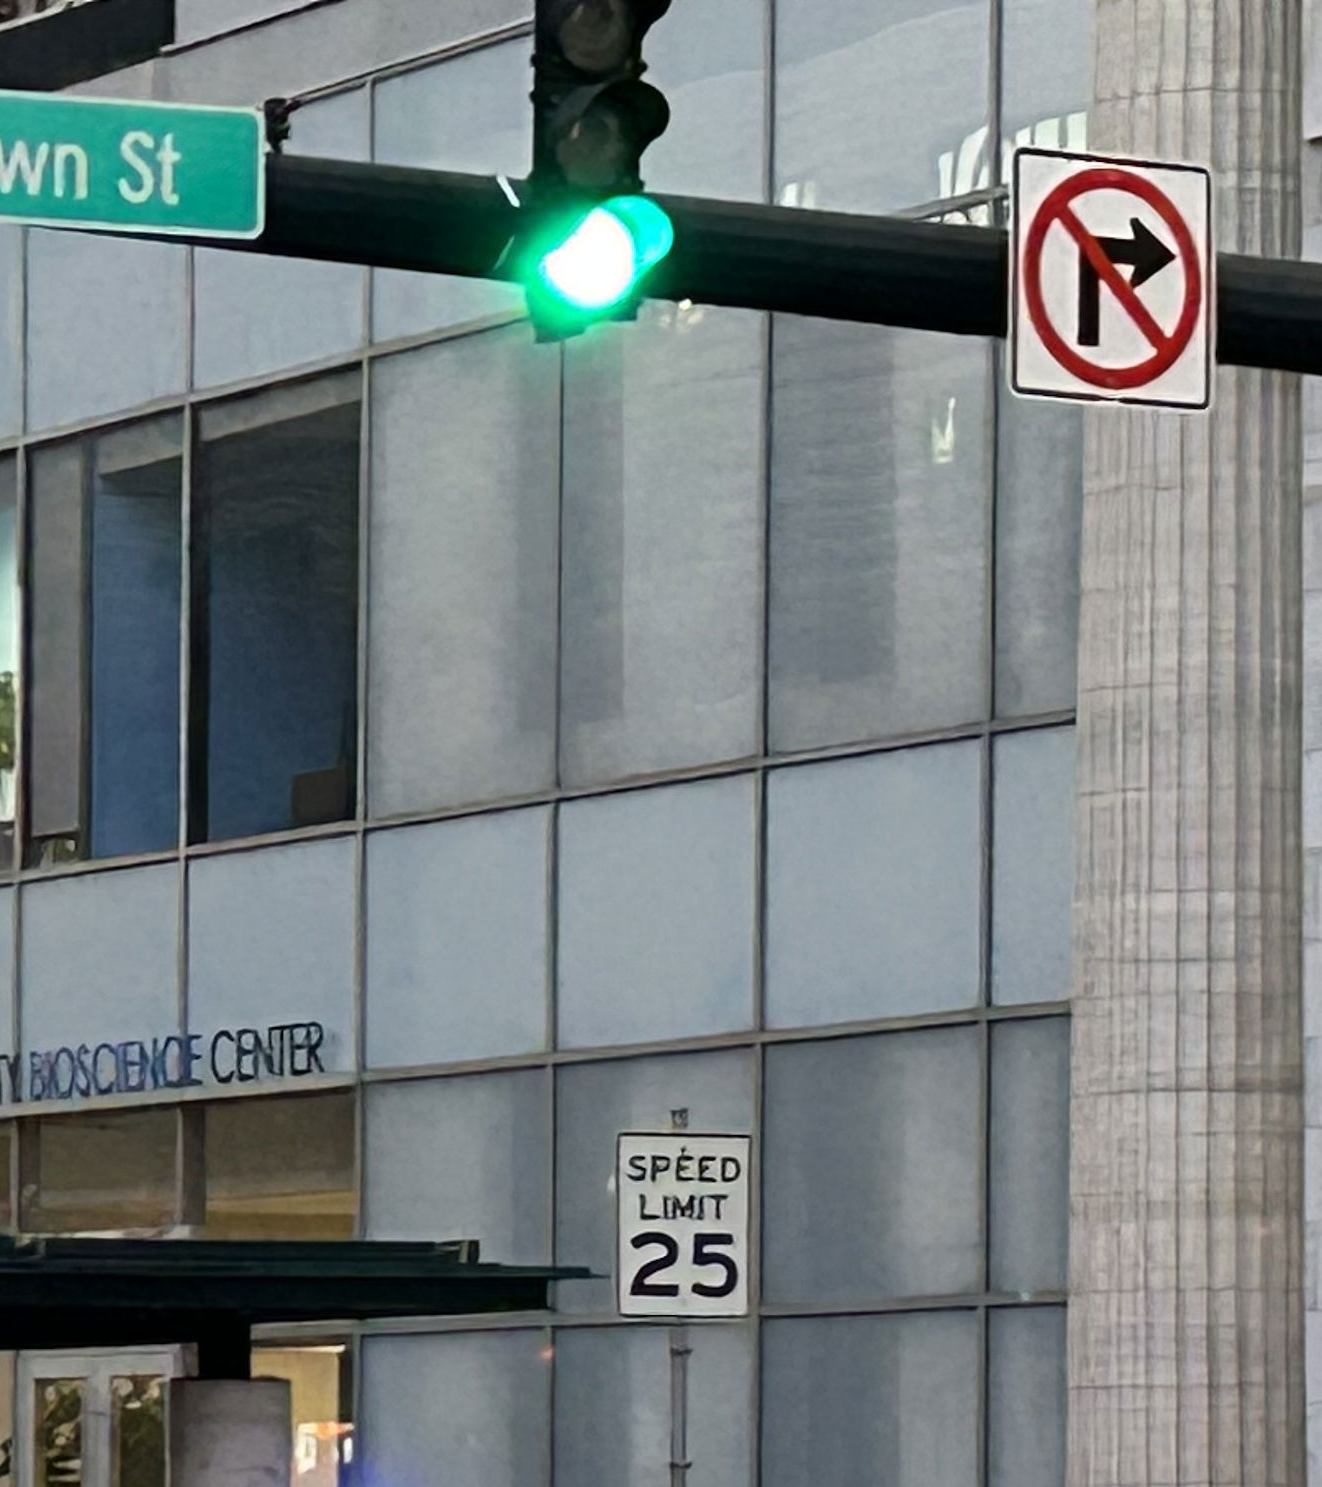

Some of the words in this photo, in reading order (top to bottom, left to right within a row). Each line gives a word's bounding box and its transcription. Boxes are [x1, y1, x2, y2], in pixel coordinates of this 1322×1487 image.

[118, 130, 182, 206] St
[30, 1034, 203, 1100] BIOSCIENCE
[211, 1021, 325, 1084] CENTER
[627, 1155, 742, 1183] SPEED
[638, 1194, 729, 1221] LIMIT
[629, 1231, 739, 1298] 25
